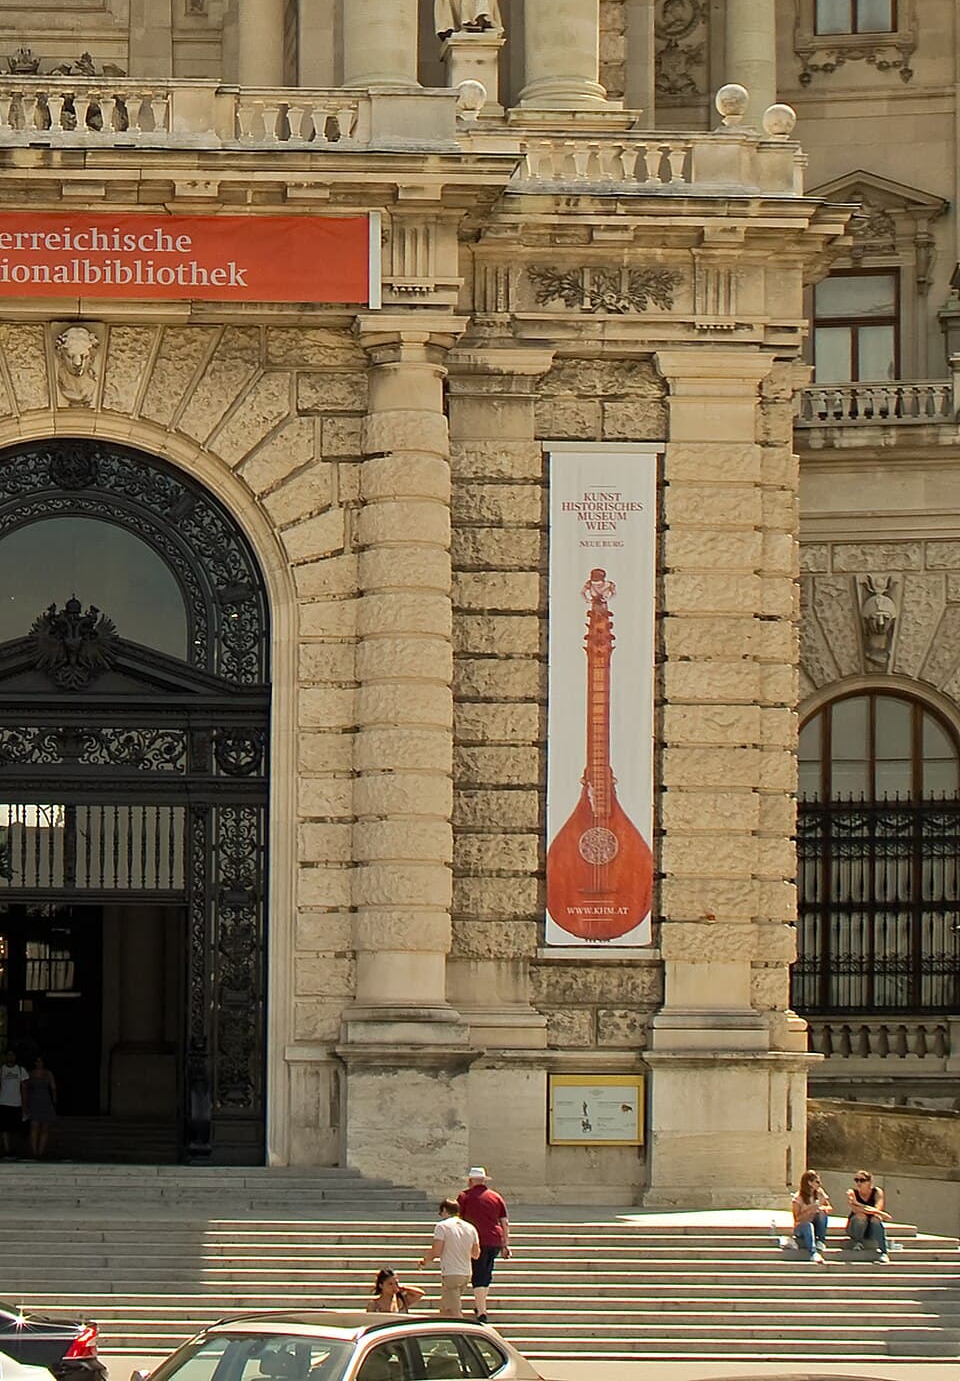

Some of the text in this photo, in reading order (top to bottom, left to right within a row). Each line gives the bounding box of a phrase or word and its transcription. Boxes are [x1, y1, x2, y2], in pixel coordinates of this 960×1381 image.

[583, 492, 622, 502] KUNST
[562, 502, 644, 512] HISTORISCHES
[577, 512, 627, 521] MUSEUM
[585, 521, 617, 531] WIEN
[579, 540, 625, 548] NEUE BURG
[566, 906, 630, 915] WWW.KHM.AT
